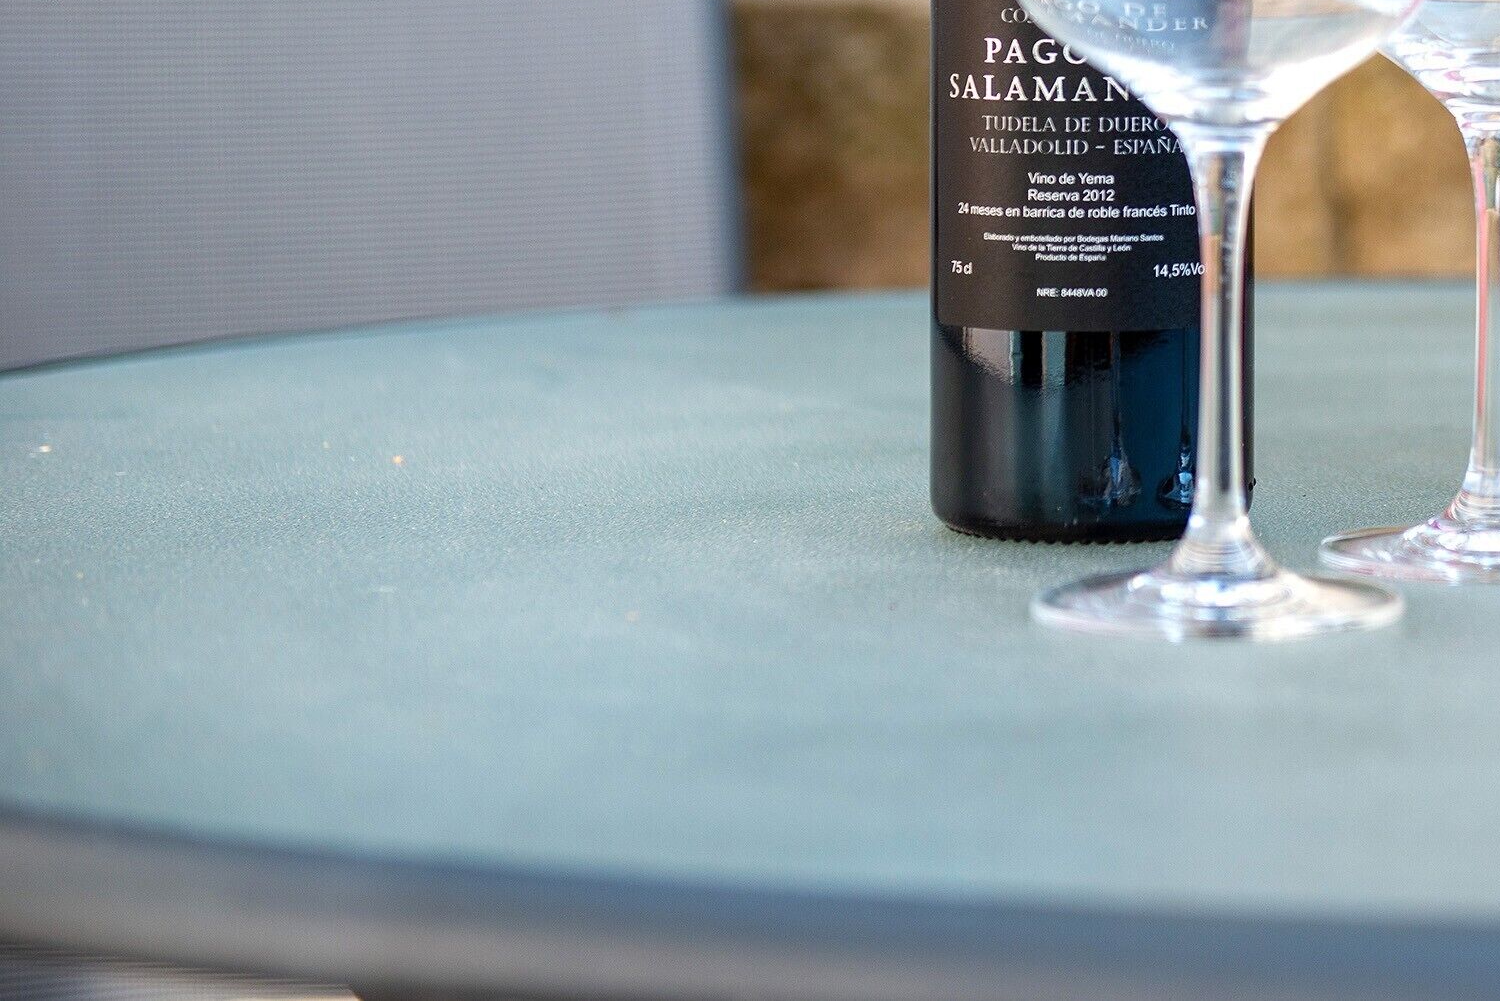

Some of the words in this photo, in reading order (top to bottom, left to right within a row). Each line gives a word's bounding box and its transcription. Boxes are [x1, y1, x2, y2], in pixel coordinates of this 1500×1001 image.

[949, 73, 1143, 102] SALAMAN
[981, 114, 1057, 132] TUDELA
[1065, 116, 1091, 133] DE
[1099, 116, 1167, 133] DUERO
[970, 137, 1090, 155] VALLADOLID
[1114, 136, 1184, 155] ESPAÑA
[1027, 172, 1056, 185] Vino
[1058, 173, 1075, 185] de
[1078, 172, 1115, 185] Yema
[1027, 189, 1080, 202] Reserva
[1082, 189, 1116, 202] 2012
[957, 202, 970, 214] 24
[970, 205, 1004, 217] meses
[1005, 207, 1021, 217] en
[1022, 206, 1066, 219] barrica
[1068, 206, 1085, 219] de
[1087, 206, 1121, 219] roble
[1122, 204, 1168, 218] francés
[1170, 204, 1196, 216] Tinto
[983, 232, 1014, 242] Elaborado
[1014, 235, 1020, 243] y
[1020, 235, 1062, 243] embotellado
[1063, 235, 1076, 244] por
[1076, 235, 1109, 244] Bodegas
[1109, 235, 1139, 243] Mariano
[1139, 233, 1165, 242] Santos
[1011, 243, 1027, 251] Vino
[1027, 243, 1038, 251] de
[1038, 243, 1046, 251] la
[1046, 243, 1068, 252] Tierra
[1068, 243, 1078, 252] de
[1079, 244, 1106, 252] Castilla
[1112, 243, 1132, 252] León
[1035, 253, 1067, 261] Producto
[1067, 253, 1078, 261] de
[1079, 253, 1107, 262] España
[950, 260, 963, 273] 75
[963, 261, 973, 275] cl
[1152, 262, 1206, 279] 14,5%Vo
[1036, 287, 1059, 297] NRE:
